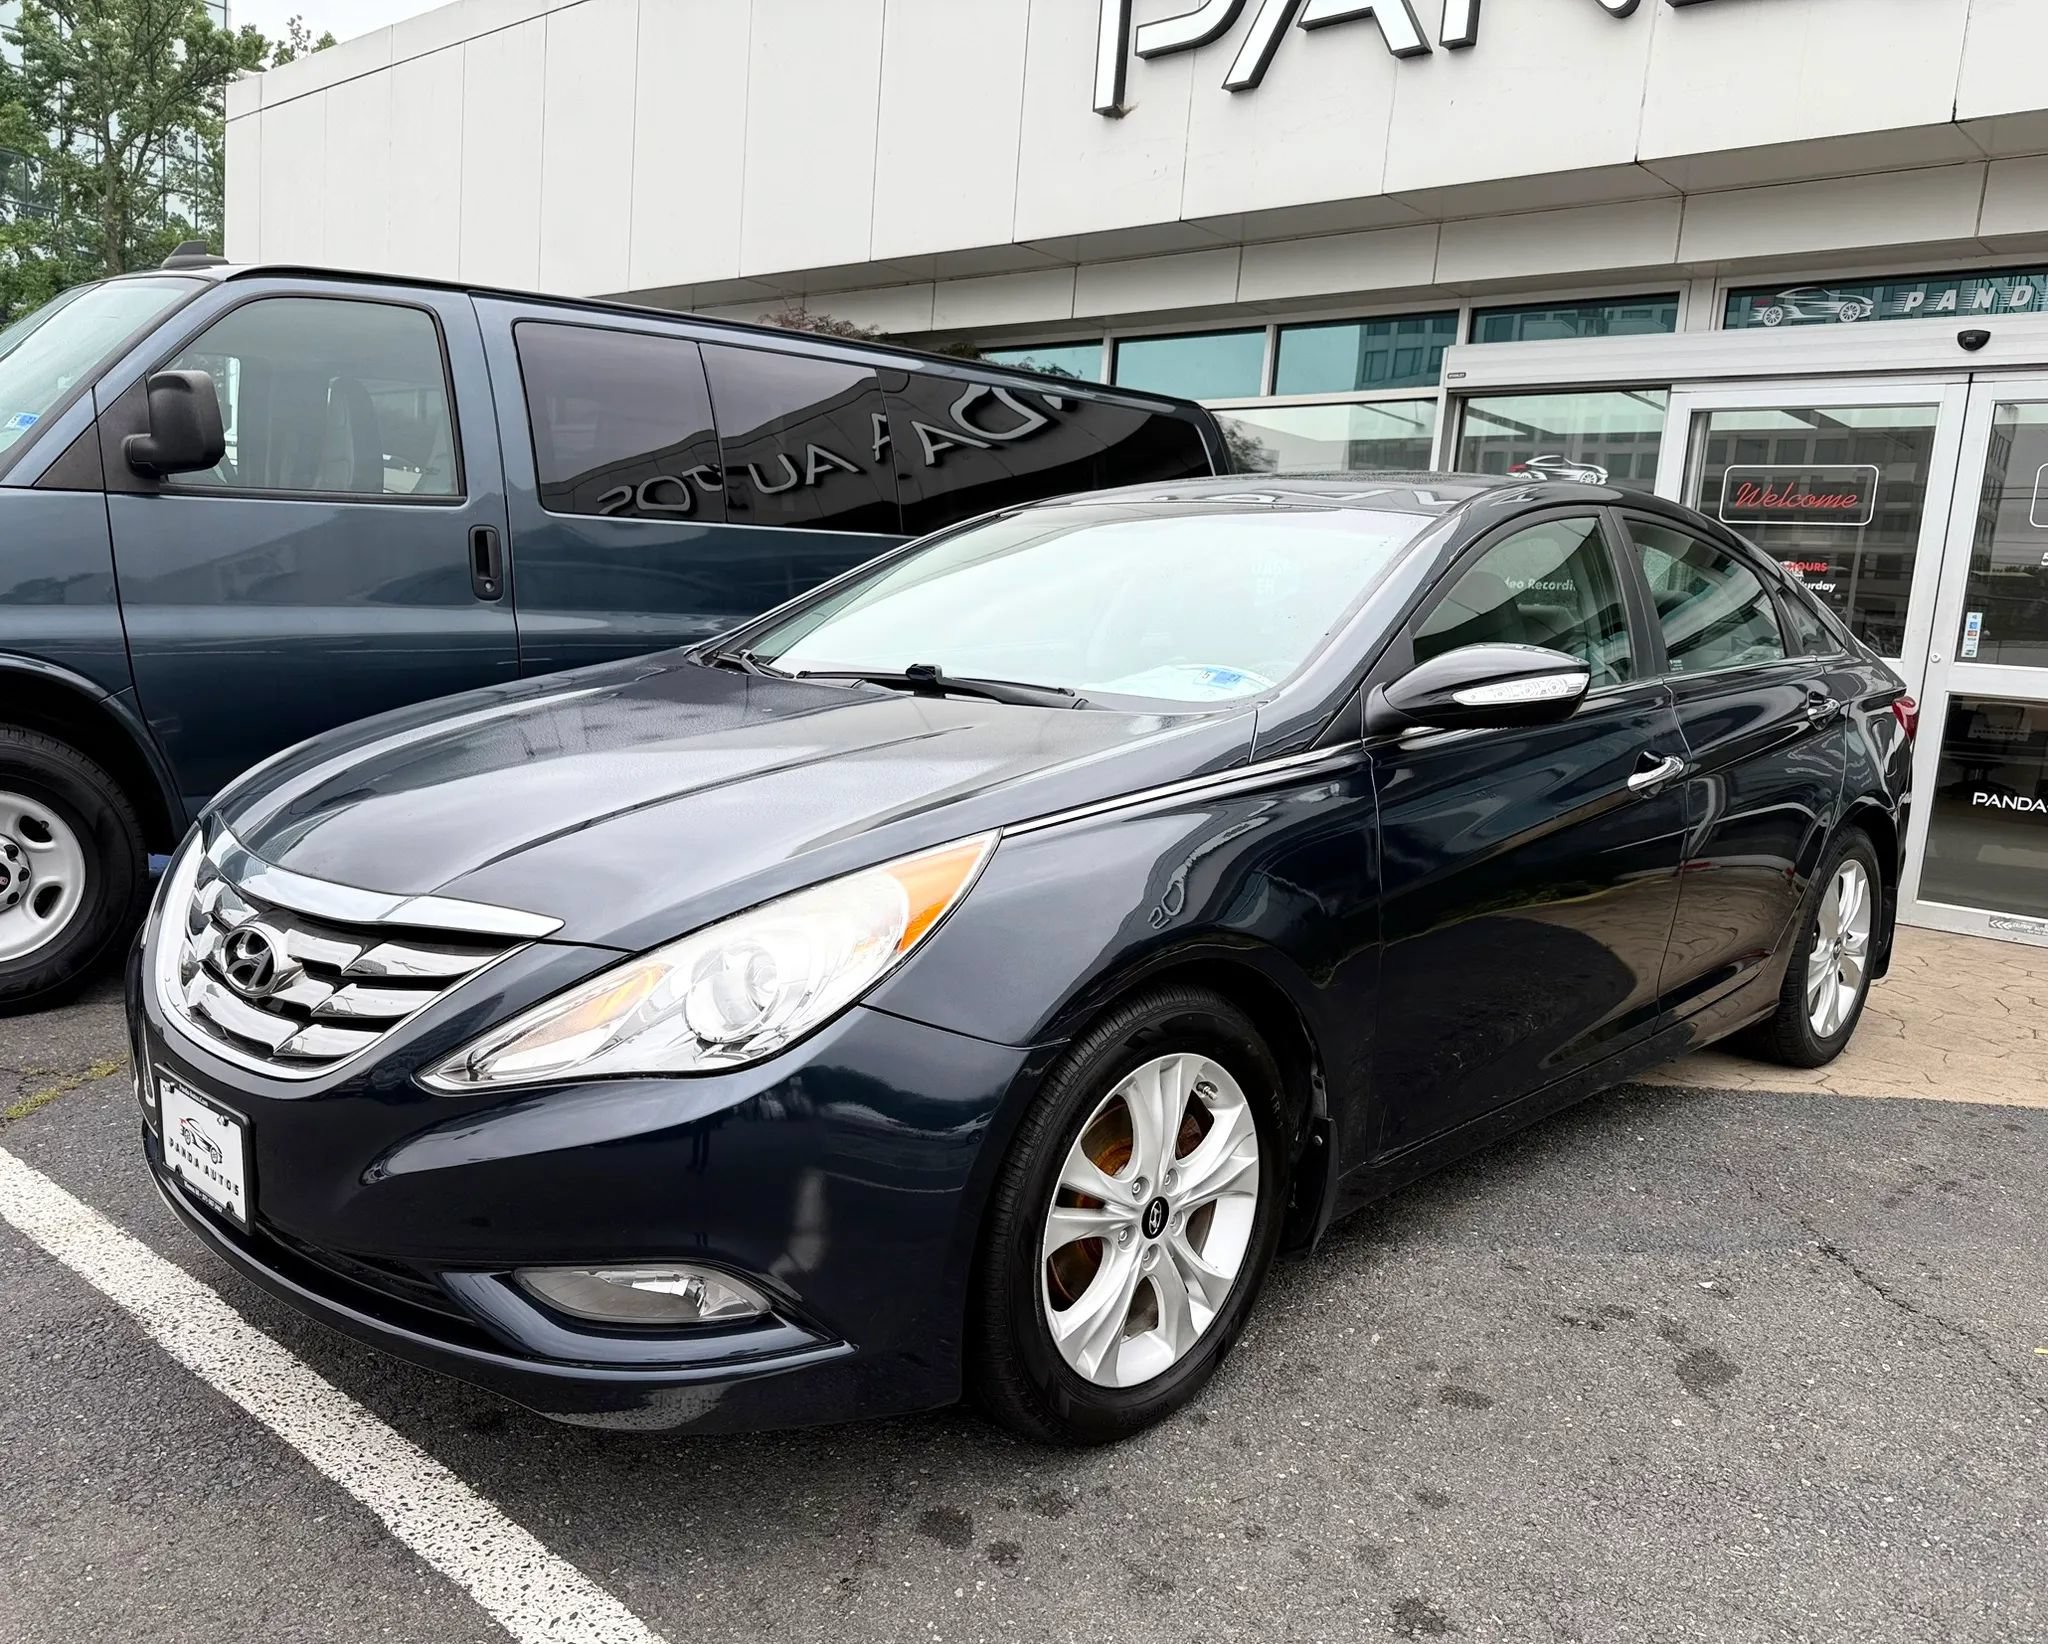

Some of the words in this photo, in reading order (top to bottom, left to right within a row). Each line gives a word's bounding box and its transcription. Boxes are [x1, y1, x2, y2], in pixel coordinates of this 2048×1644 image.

[1901, 285, 2034, 313] PAND
[1734, 481, 1858, 509] Welcome
[1527, 578, 1577, 592] Recordi
[1972, 791, 2048, 814] PANDA
[205, 1165, 240, 1196] AUTOS
